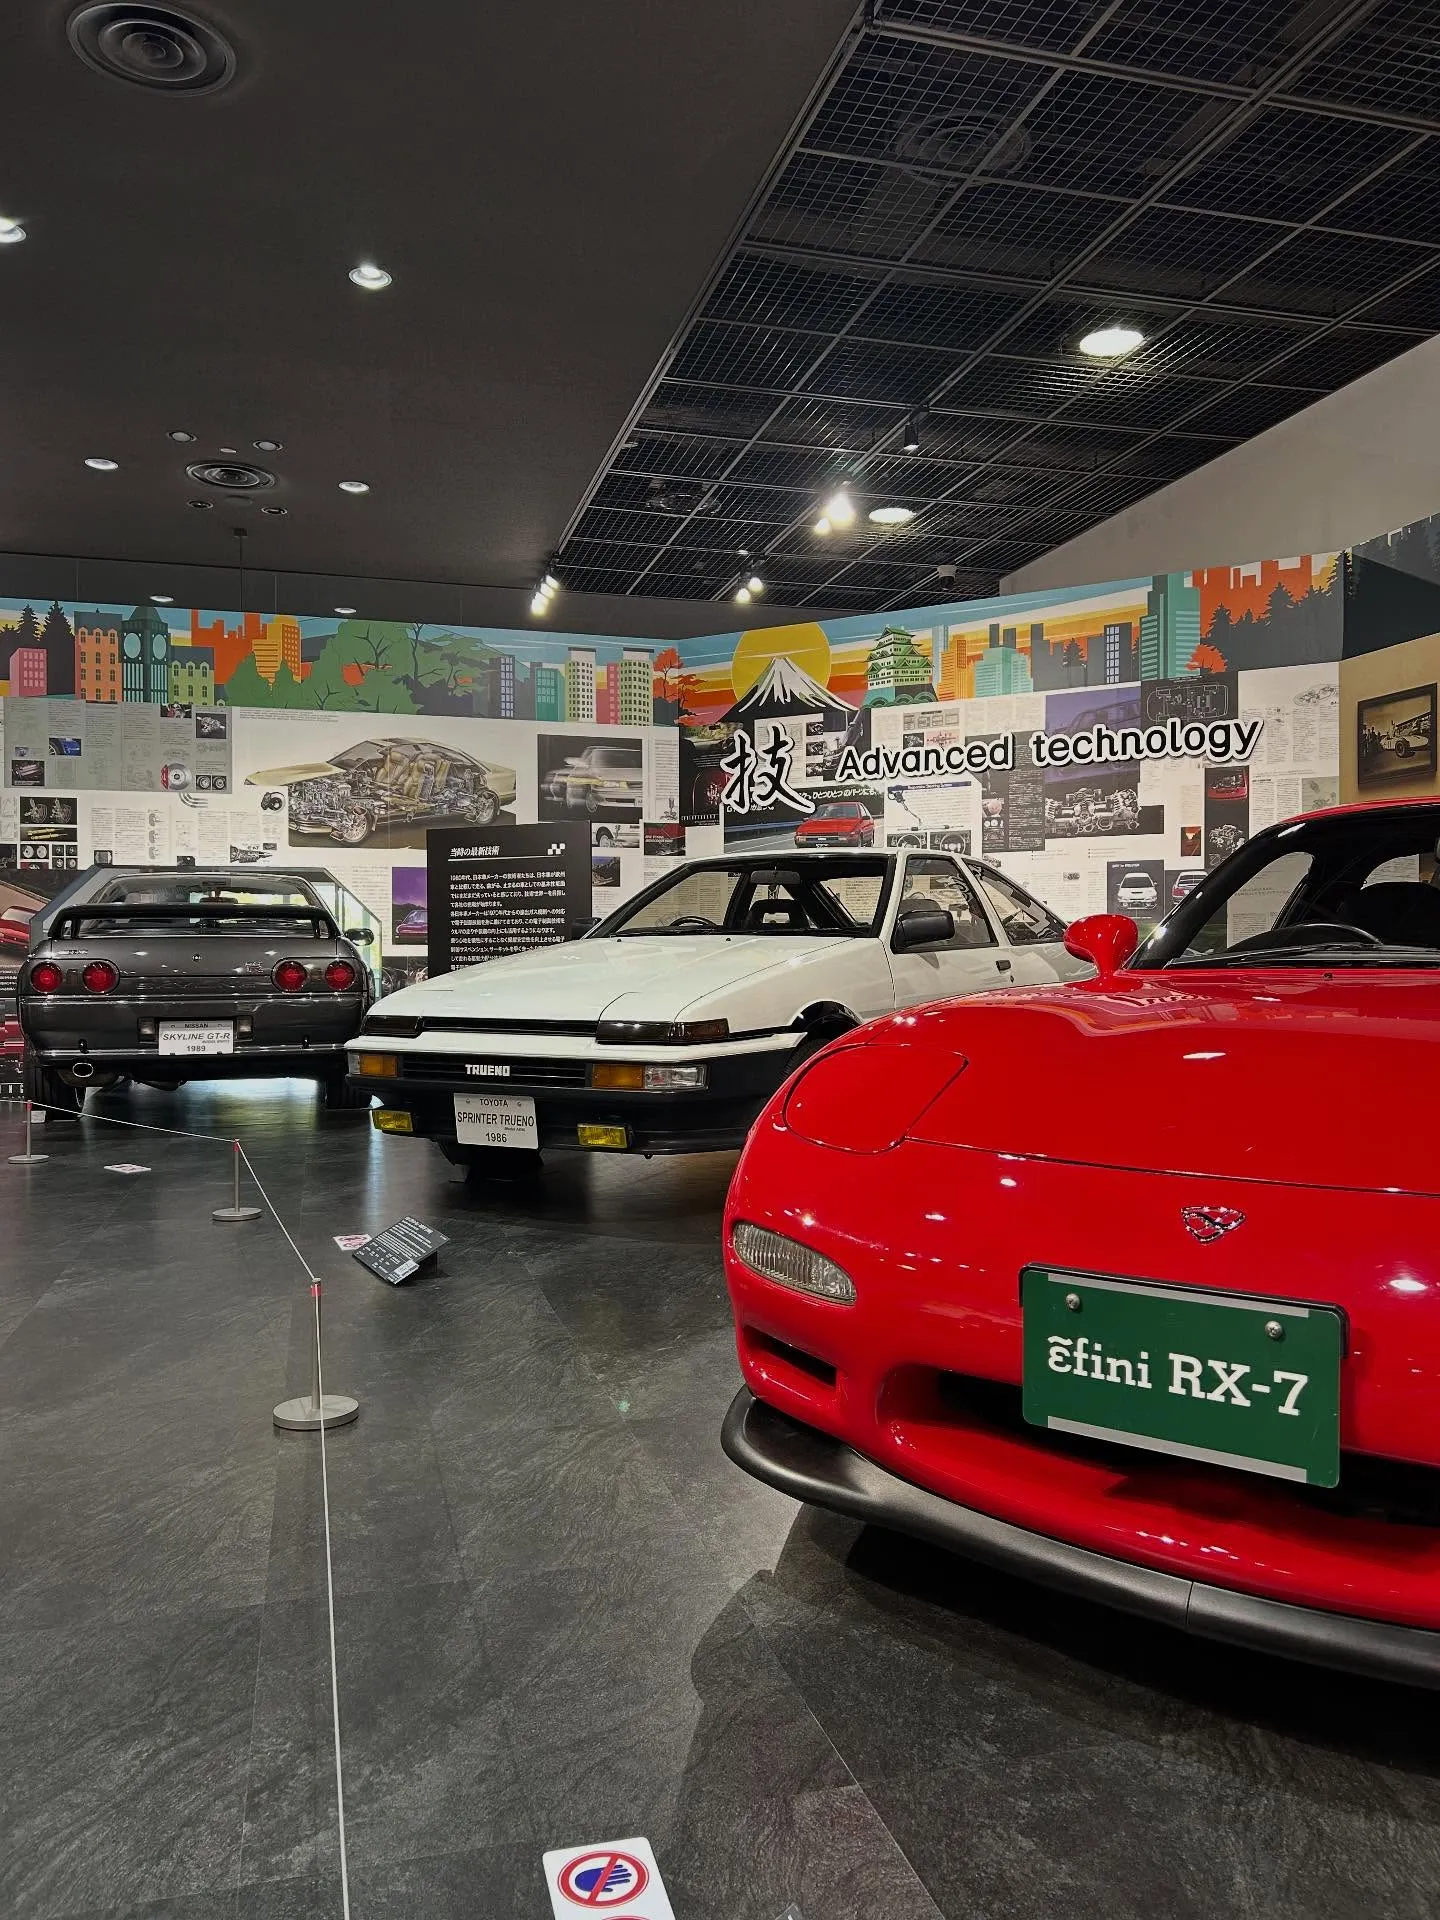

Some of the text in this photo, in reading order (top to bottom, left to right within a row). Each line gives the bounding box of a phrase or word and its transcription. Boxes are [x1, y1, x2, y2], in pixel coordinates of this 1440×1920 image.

[838, 734, 1013, 779] Advanced
[1032, 720, 1261, 763] technology
[722, 725, 814, 812] 技
[450, 845, 500, 857] 当時の最新技術
[162, 1032, 231, 1041] SKYLINE GT-R
[464, 1064, 511, 1077] TRUENO
[479, 1098, 509, 1108] TOYOTA
[457, 1111, 535, 1127] SPRINTER TRUENO
[485, 1132, 508, 1143] 1986
[1168, 1352, 1309, 1417] RX-7
